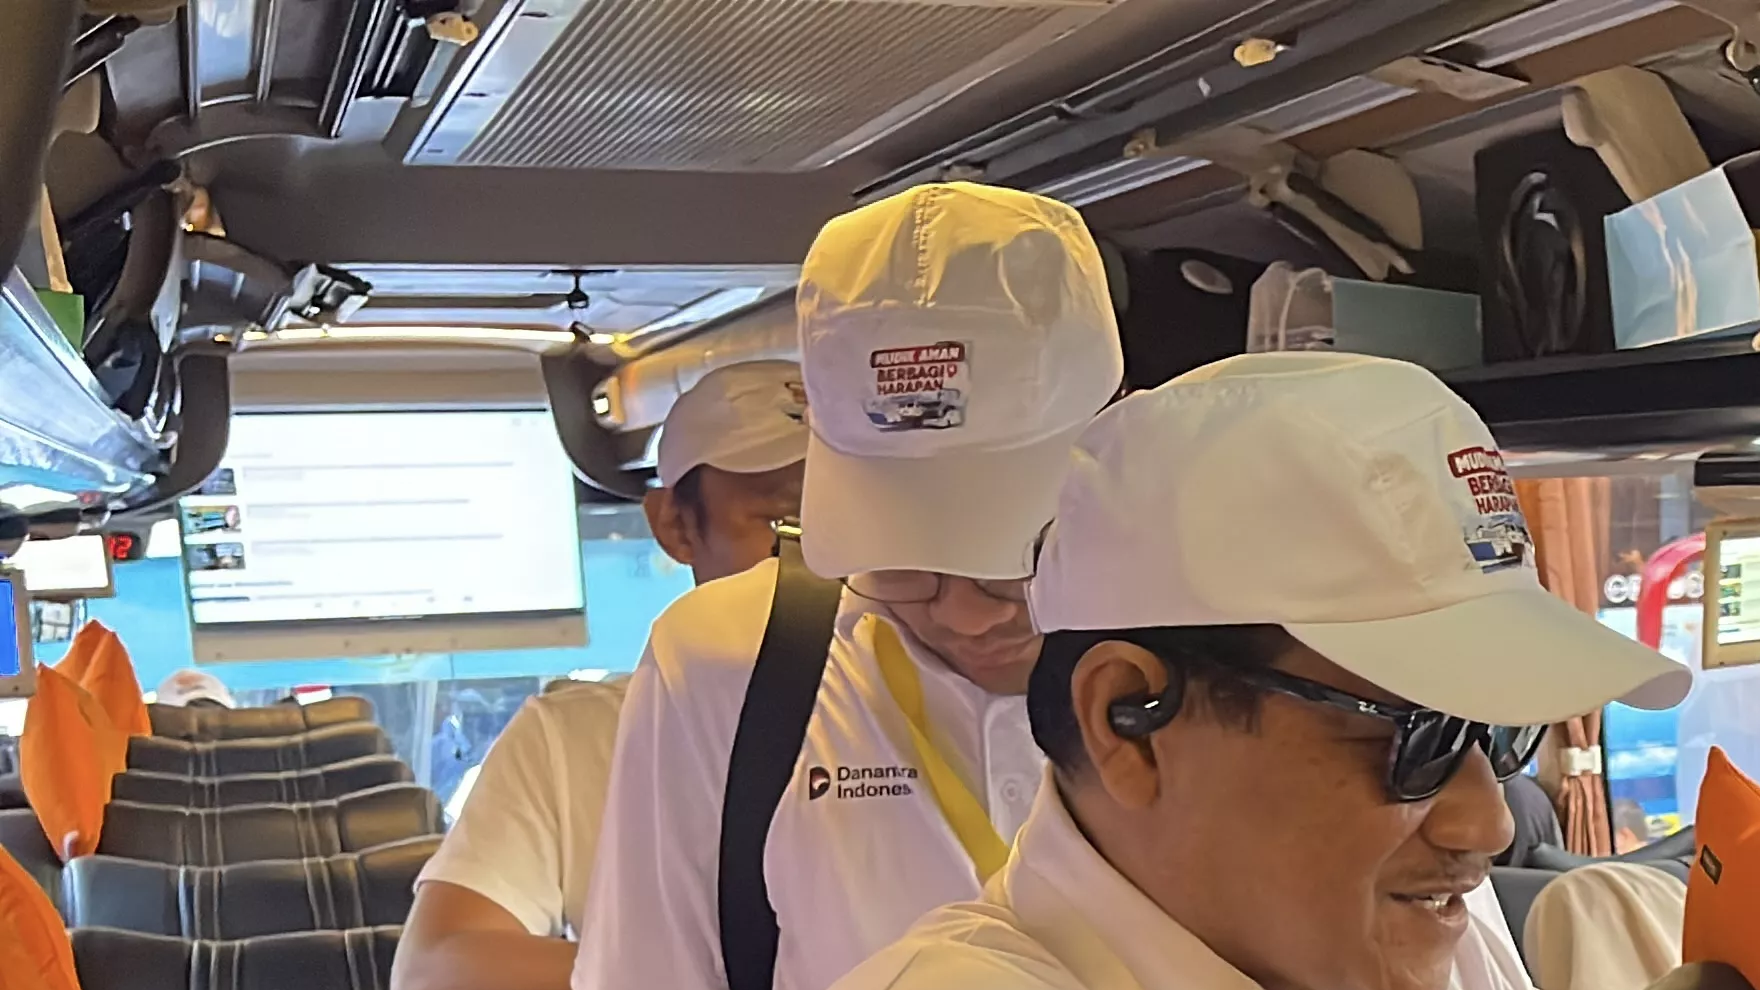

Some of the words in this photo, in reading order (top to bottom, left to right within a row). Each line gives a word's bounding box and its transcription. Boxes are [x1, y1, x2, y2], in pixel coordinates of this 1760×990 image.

[918, 346, 960, 362] AMAN
[877, 363, 944, 383] BERBAGI
[877, 378, 944, 396] HARAPAN
